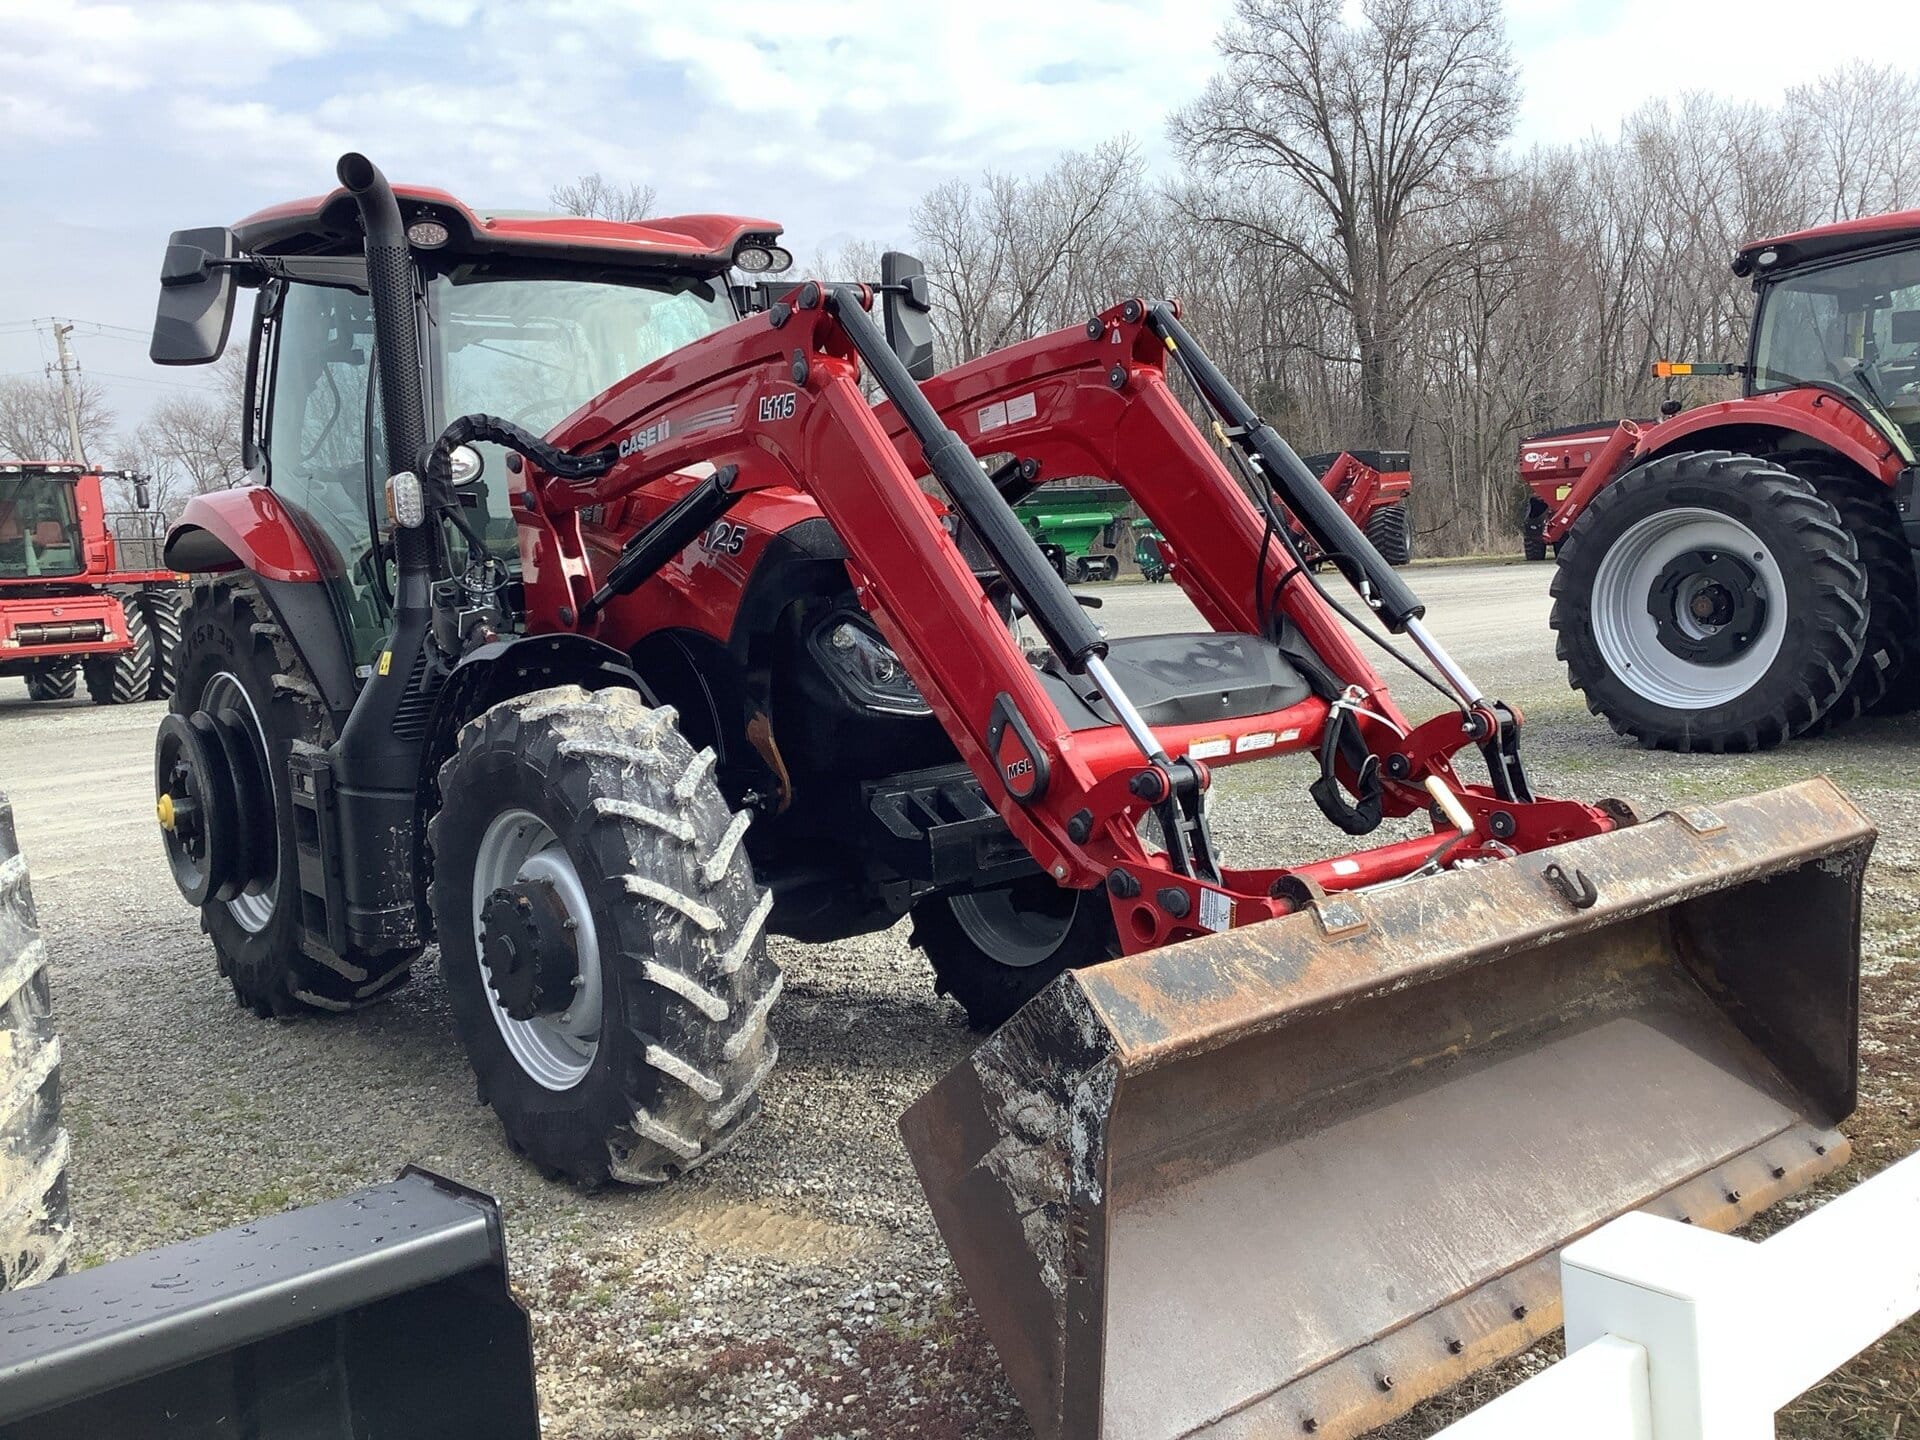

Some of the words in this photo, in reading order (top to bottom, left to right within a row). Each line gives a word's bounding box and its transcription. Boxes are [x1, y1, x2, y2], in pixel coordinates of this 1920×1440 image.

[759, 392, 796, 422] L115
[619, 426, 657, 458] CASE
[1007, 758, 1033, 780] MSL
